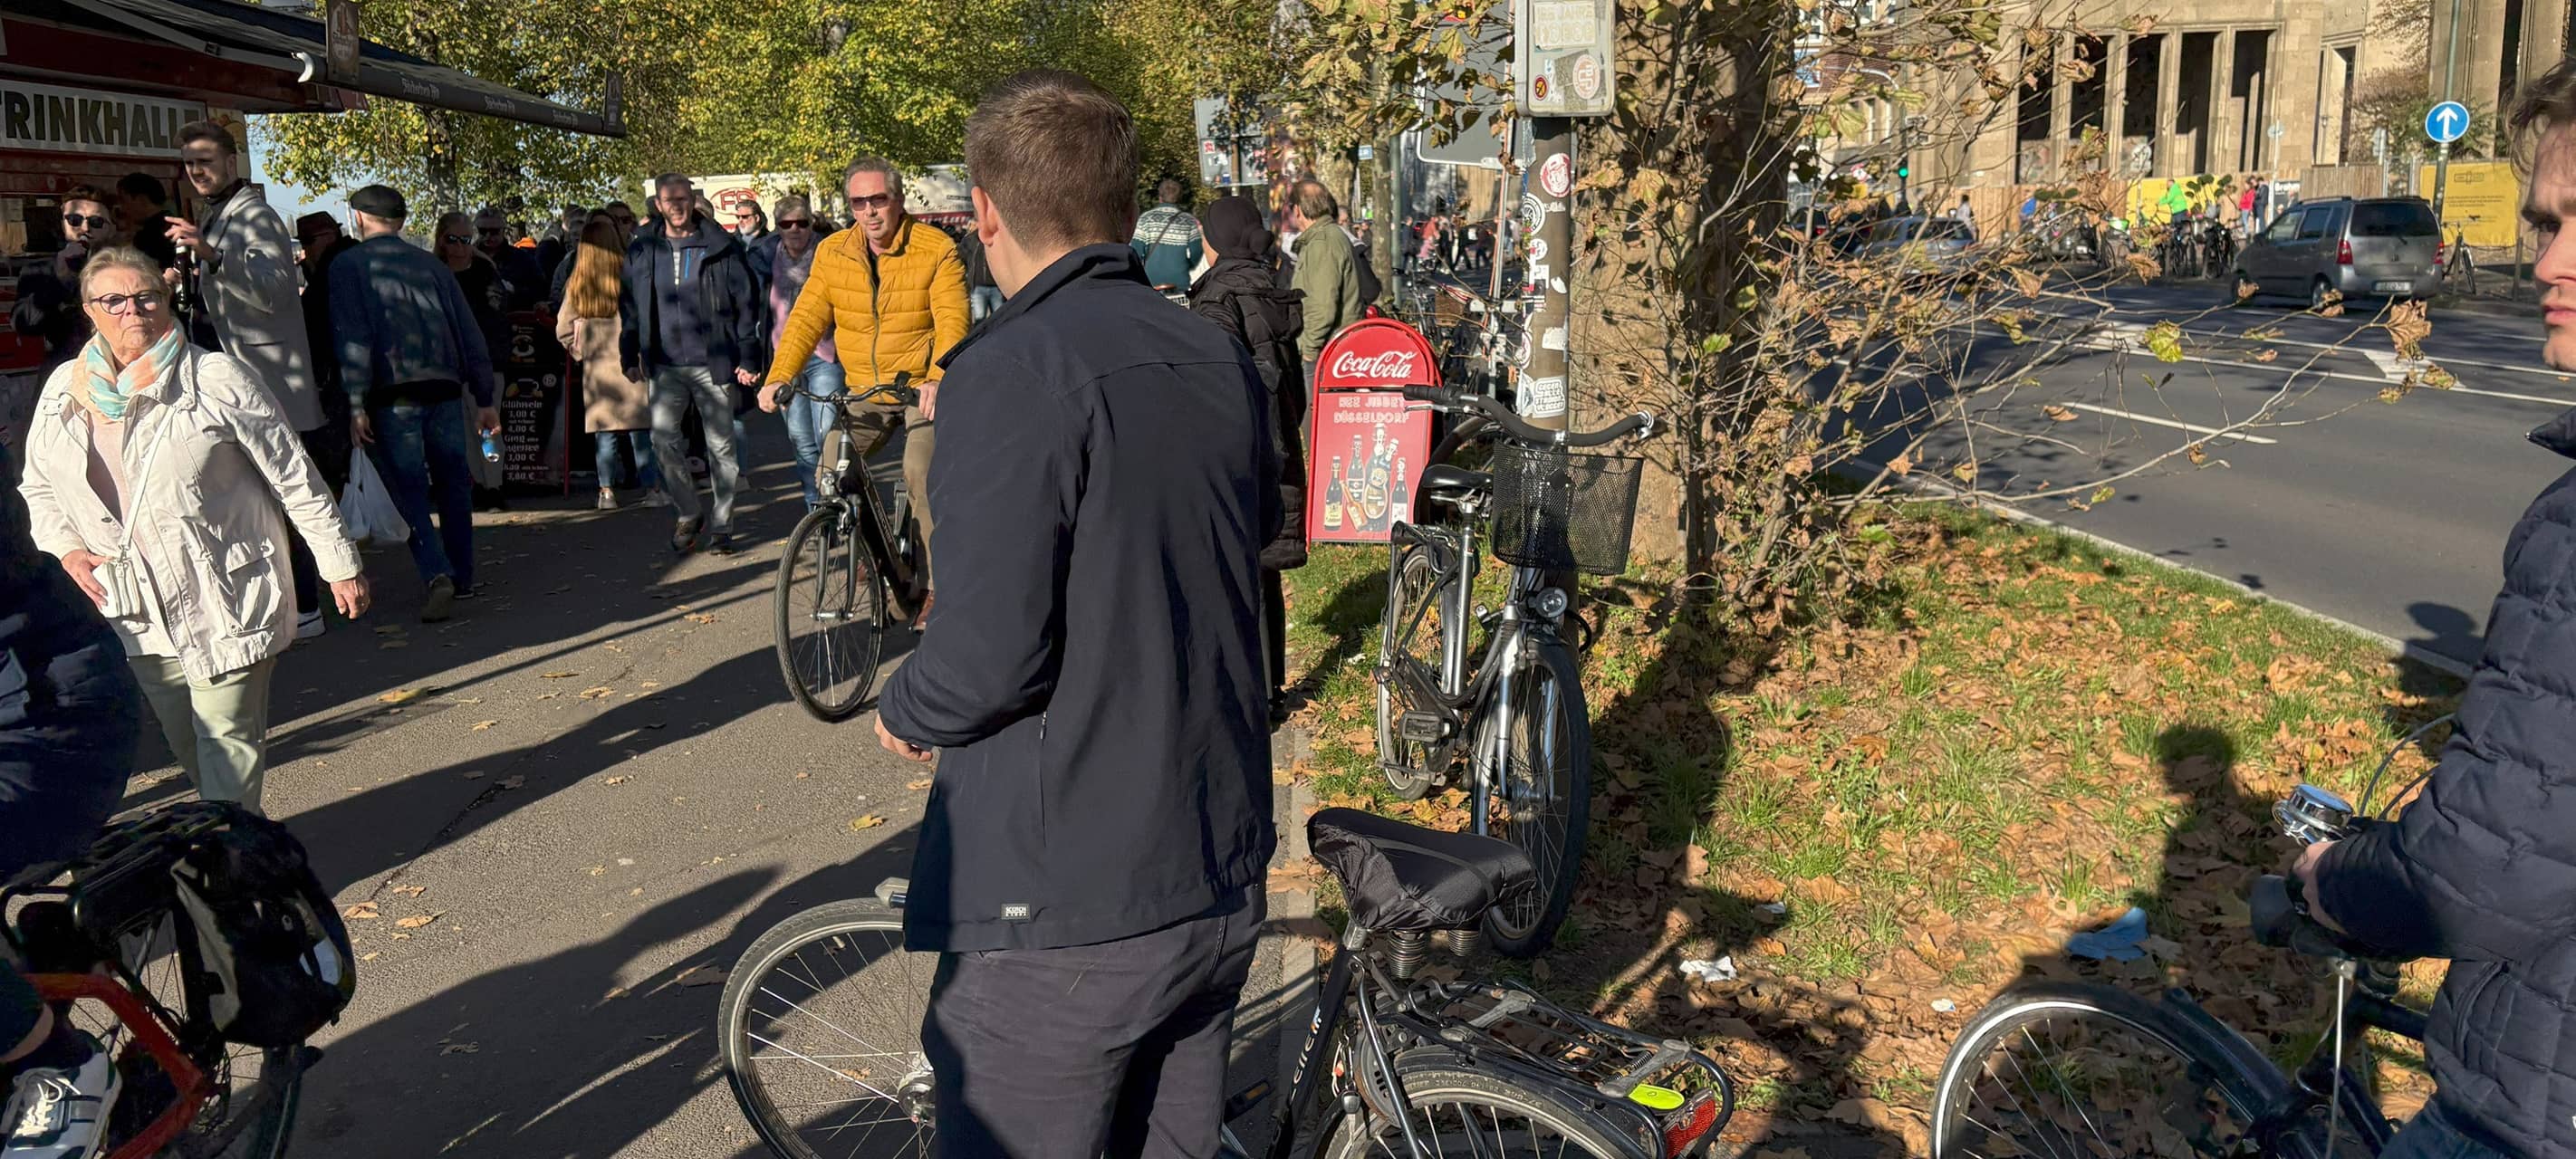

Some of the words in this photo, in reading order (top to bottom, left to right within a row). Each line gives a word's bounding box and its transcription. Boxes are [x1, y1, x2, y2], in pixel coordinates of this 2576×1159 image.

[0, 91, 198, 149] RINKHALL
[1332, 350, 1417, 378] Coca-Cola
[503, 400, 543, 408] Glühwein
[1333, 410, 1410, 423] DÜSSELDORF
